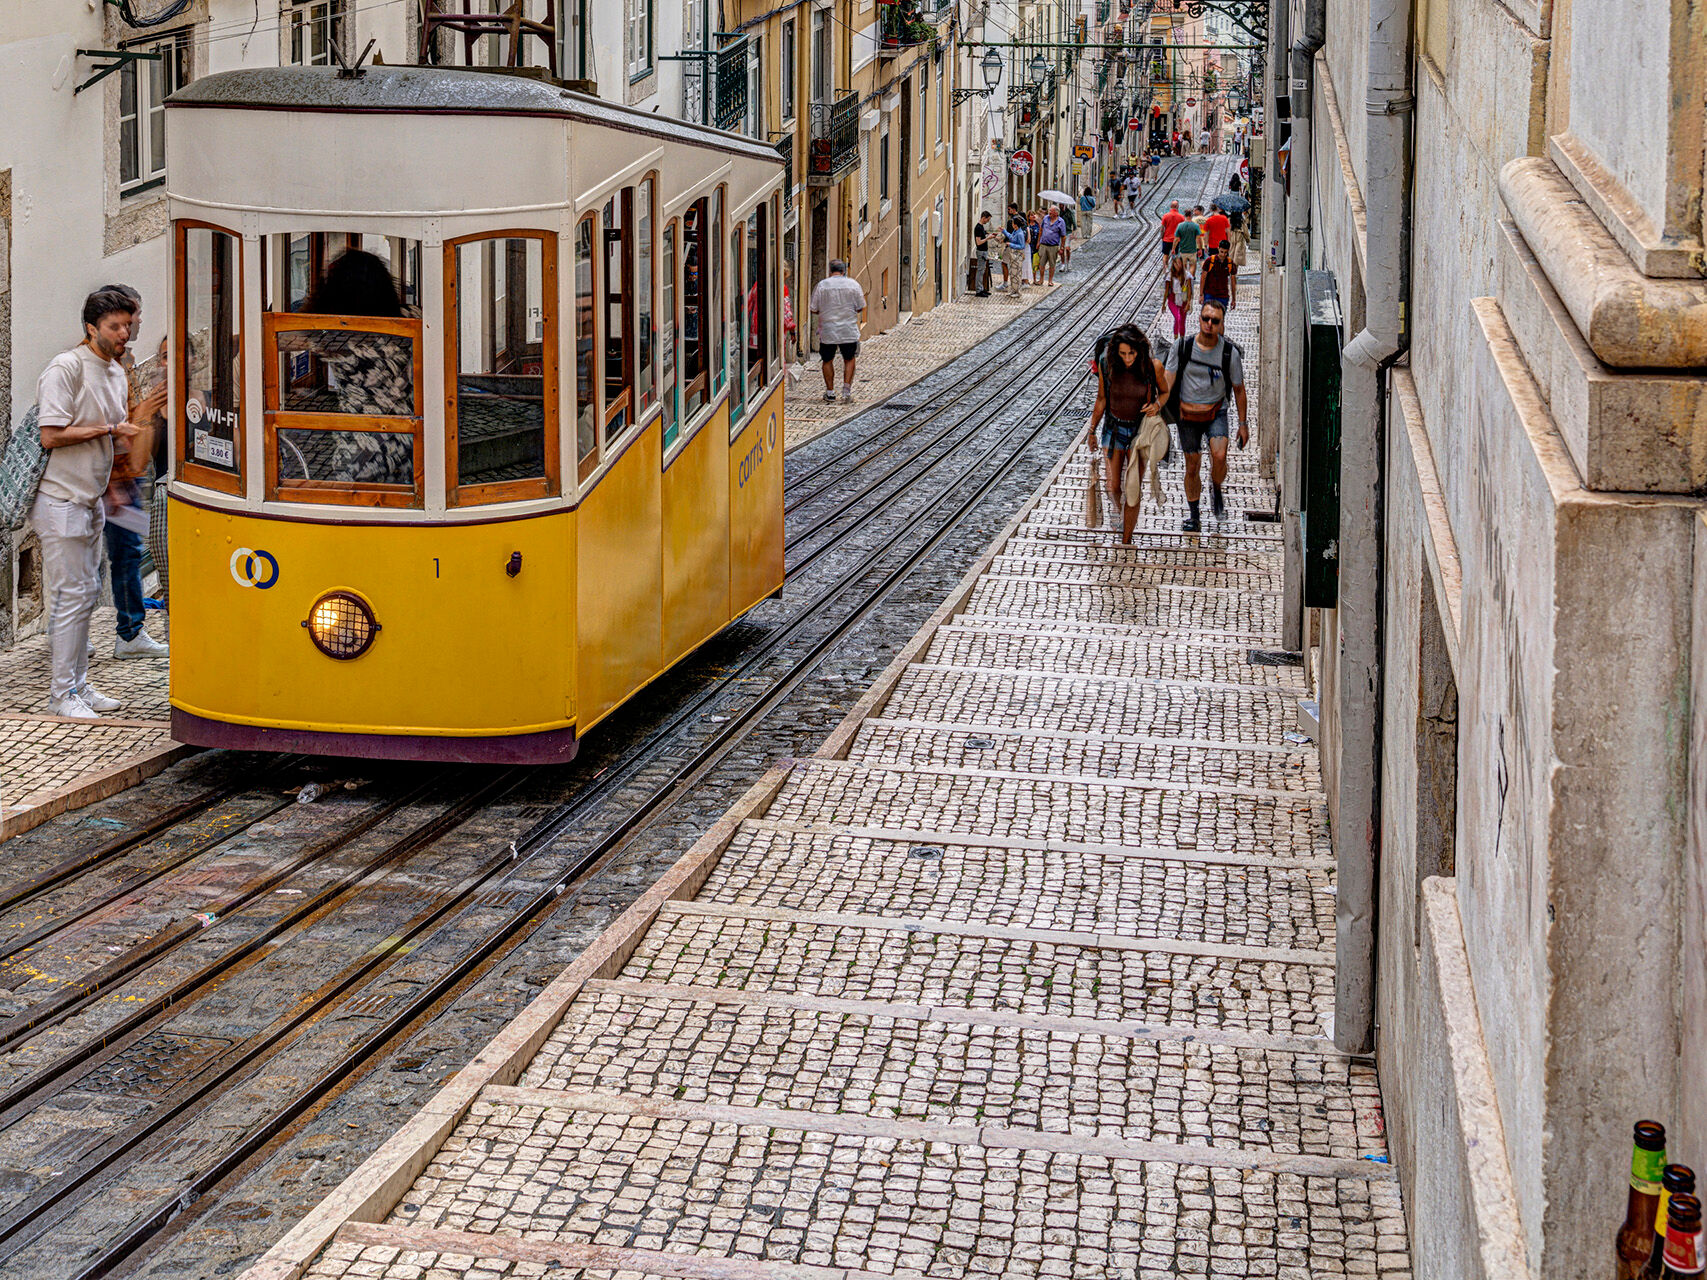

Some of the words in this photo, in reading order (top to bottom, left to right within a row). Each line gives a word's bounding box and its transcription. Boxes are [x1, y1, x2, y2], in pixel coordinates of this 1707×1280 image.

[205, 407, 238, 429] WI-FI
[739, 429, 763, 488] carris
[433, 558, 439, 578] 1
